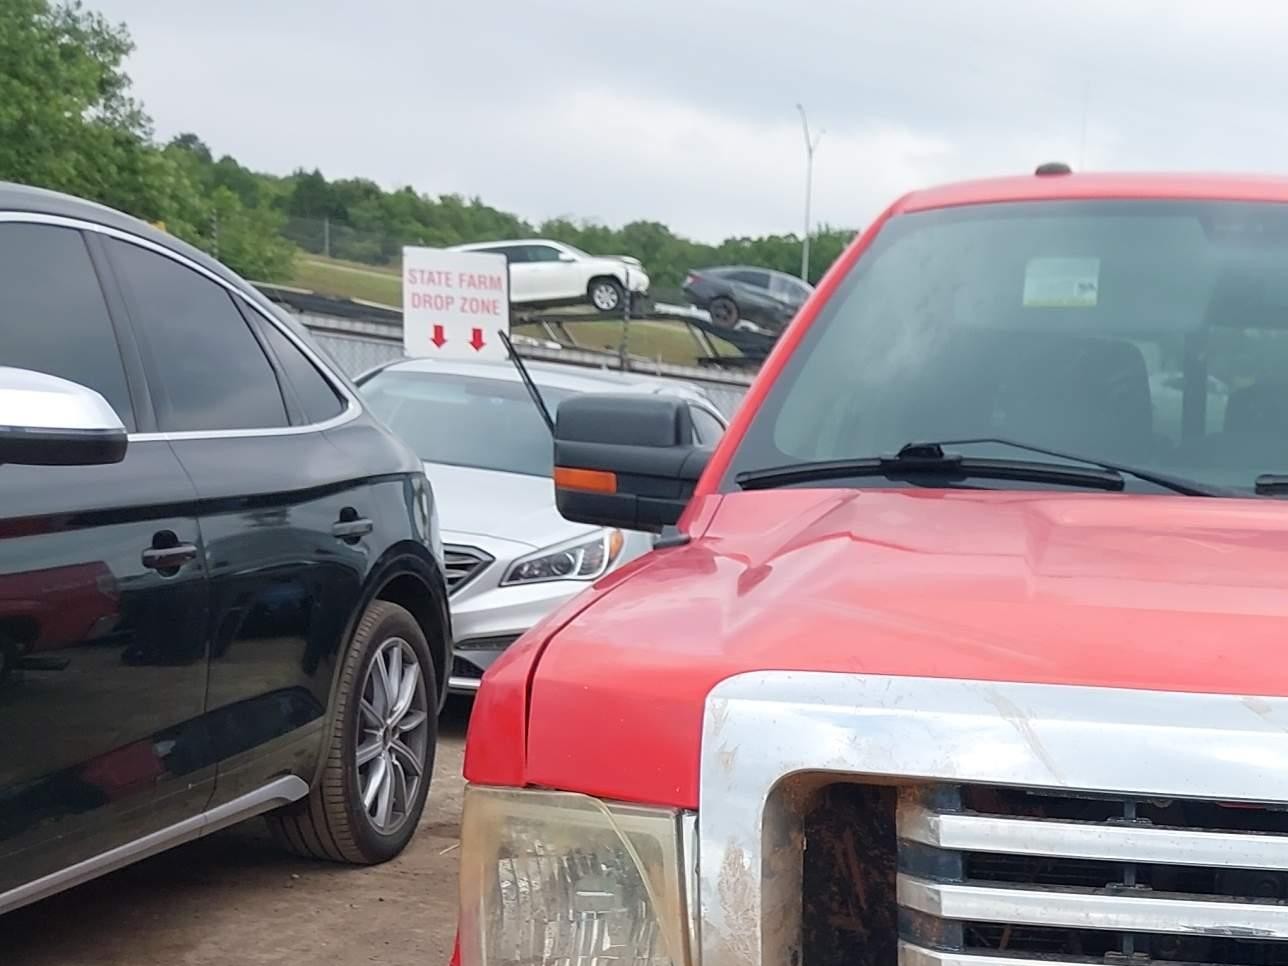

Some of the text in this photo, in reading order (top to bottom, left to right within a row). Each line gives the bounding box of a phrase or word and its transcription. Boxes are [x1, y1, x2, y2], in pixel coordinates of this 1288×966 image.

[408, 269, 503, 292] STATE FARM
[411, 292, 501, 315] DROP ZONE
